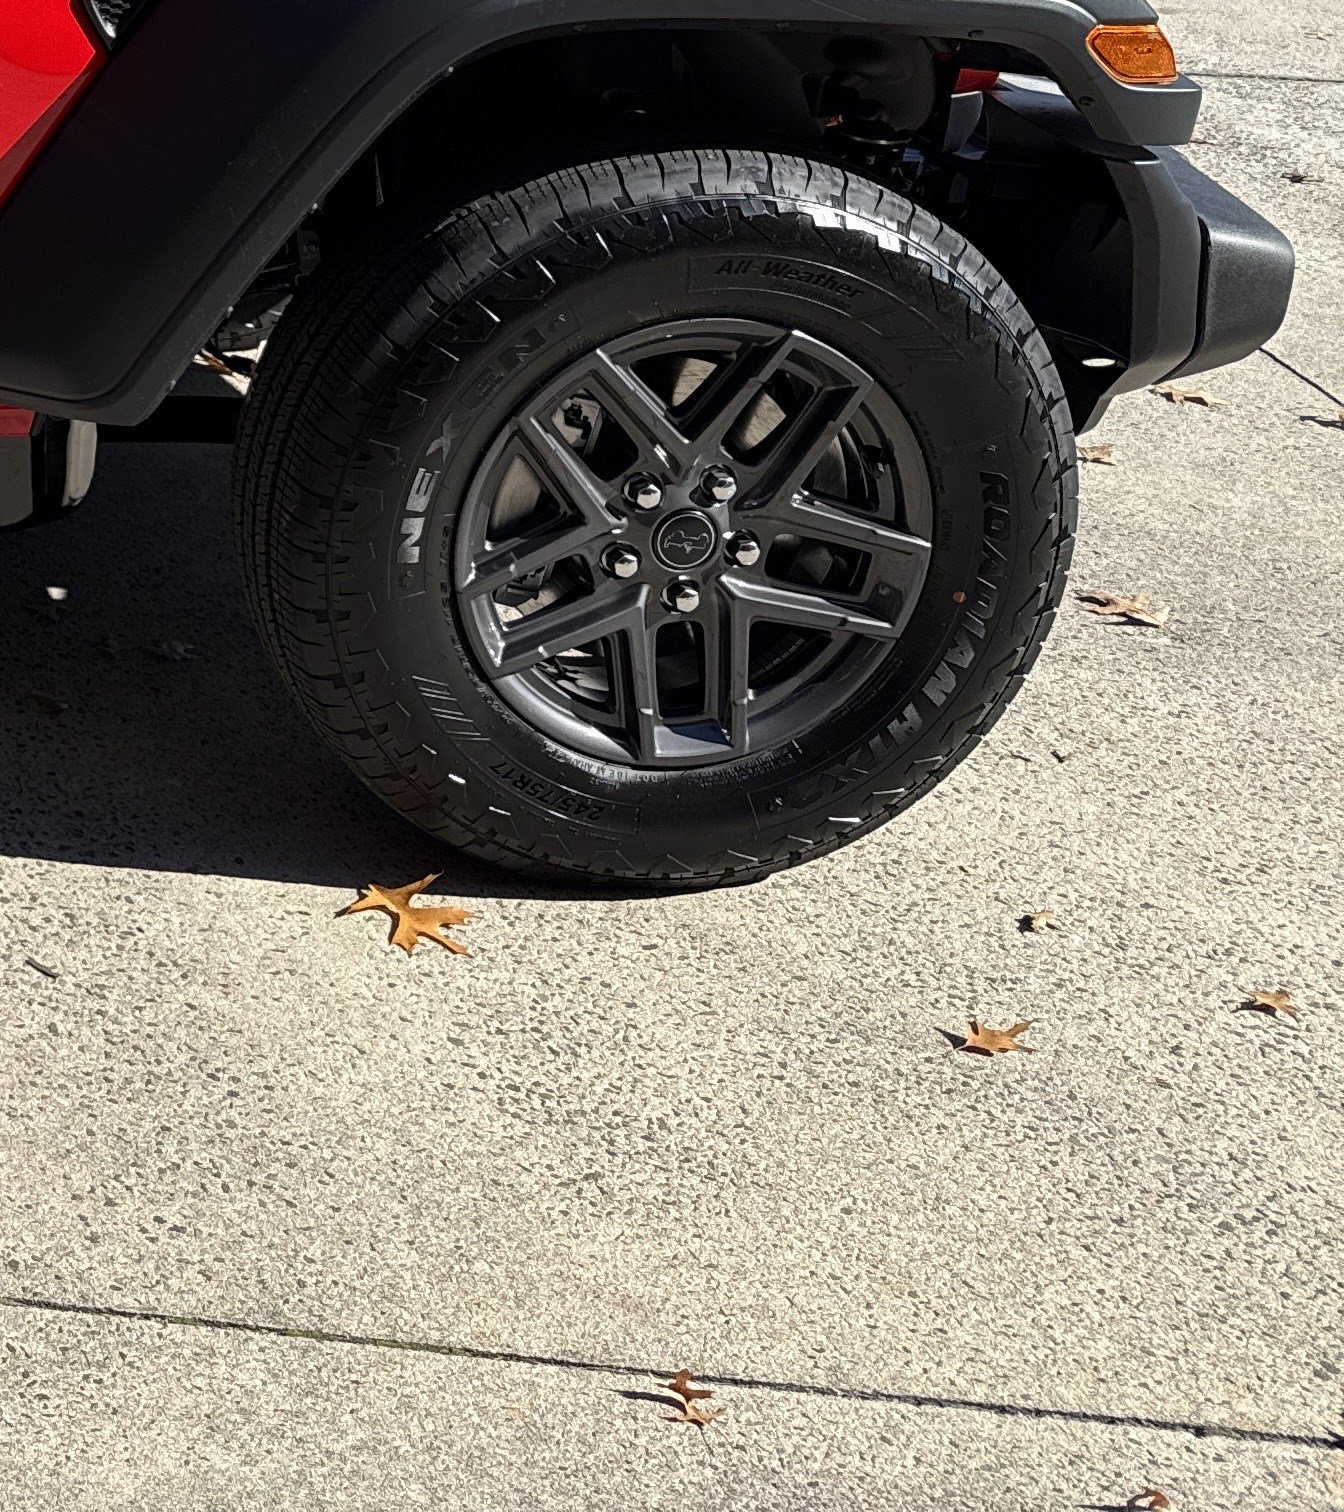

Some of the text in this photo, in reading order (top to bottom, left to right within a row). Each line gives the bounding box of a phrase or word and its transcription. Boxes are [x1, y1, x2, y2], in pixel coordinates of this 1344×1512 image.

[714, 258, 865, 299] All-Weather
[396, 328, 546, 564] NEXEN
[921, 470, 1012, 708] ROADIAN
[488, 761, 607, 822] 245/75R17
